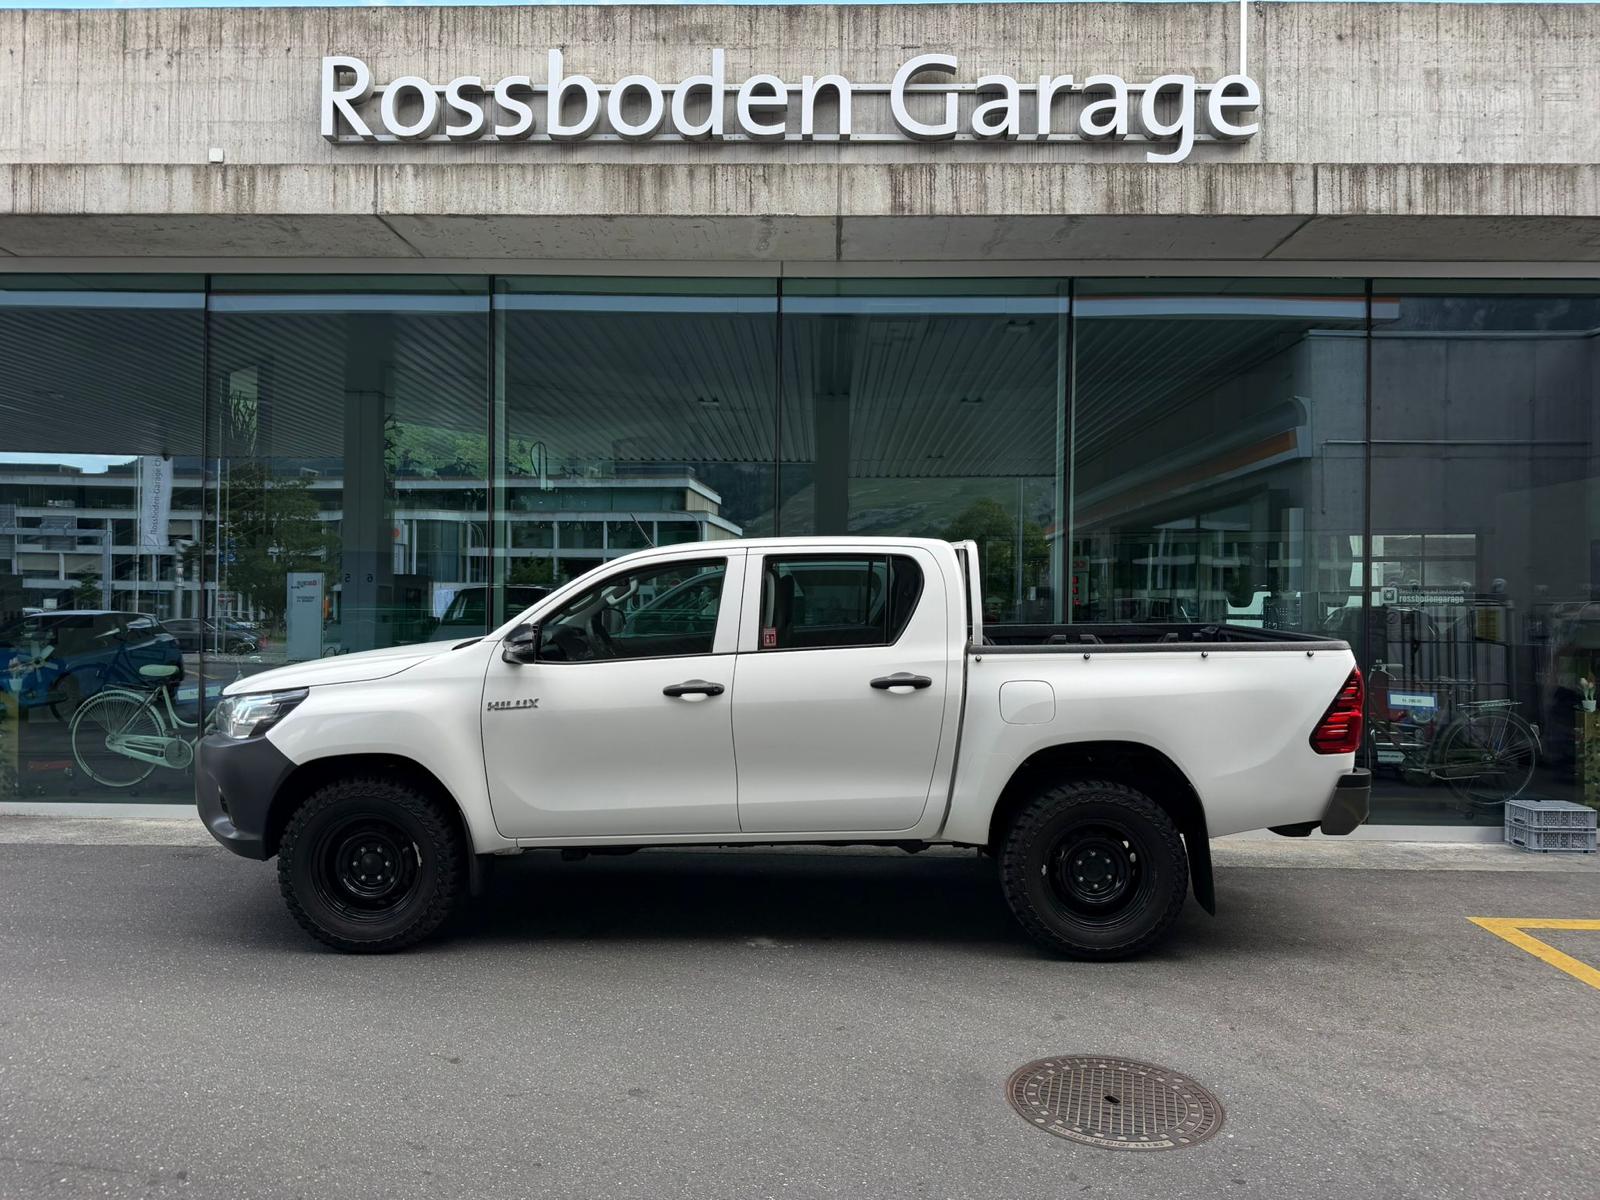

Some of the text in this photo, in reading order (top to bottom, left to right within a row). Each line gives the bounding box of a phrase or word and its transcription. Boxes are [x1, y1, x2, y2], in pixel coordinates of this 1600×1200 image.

[321, 48, 1261, 163] Rossboden Garage
[487, 697, 540, 711] HILUX
